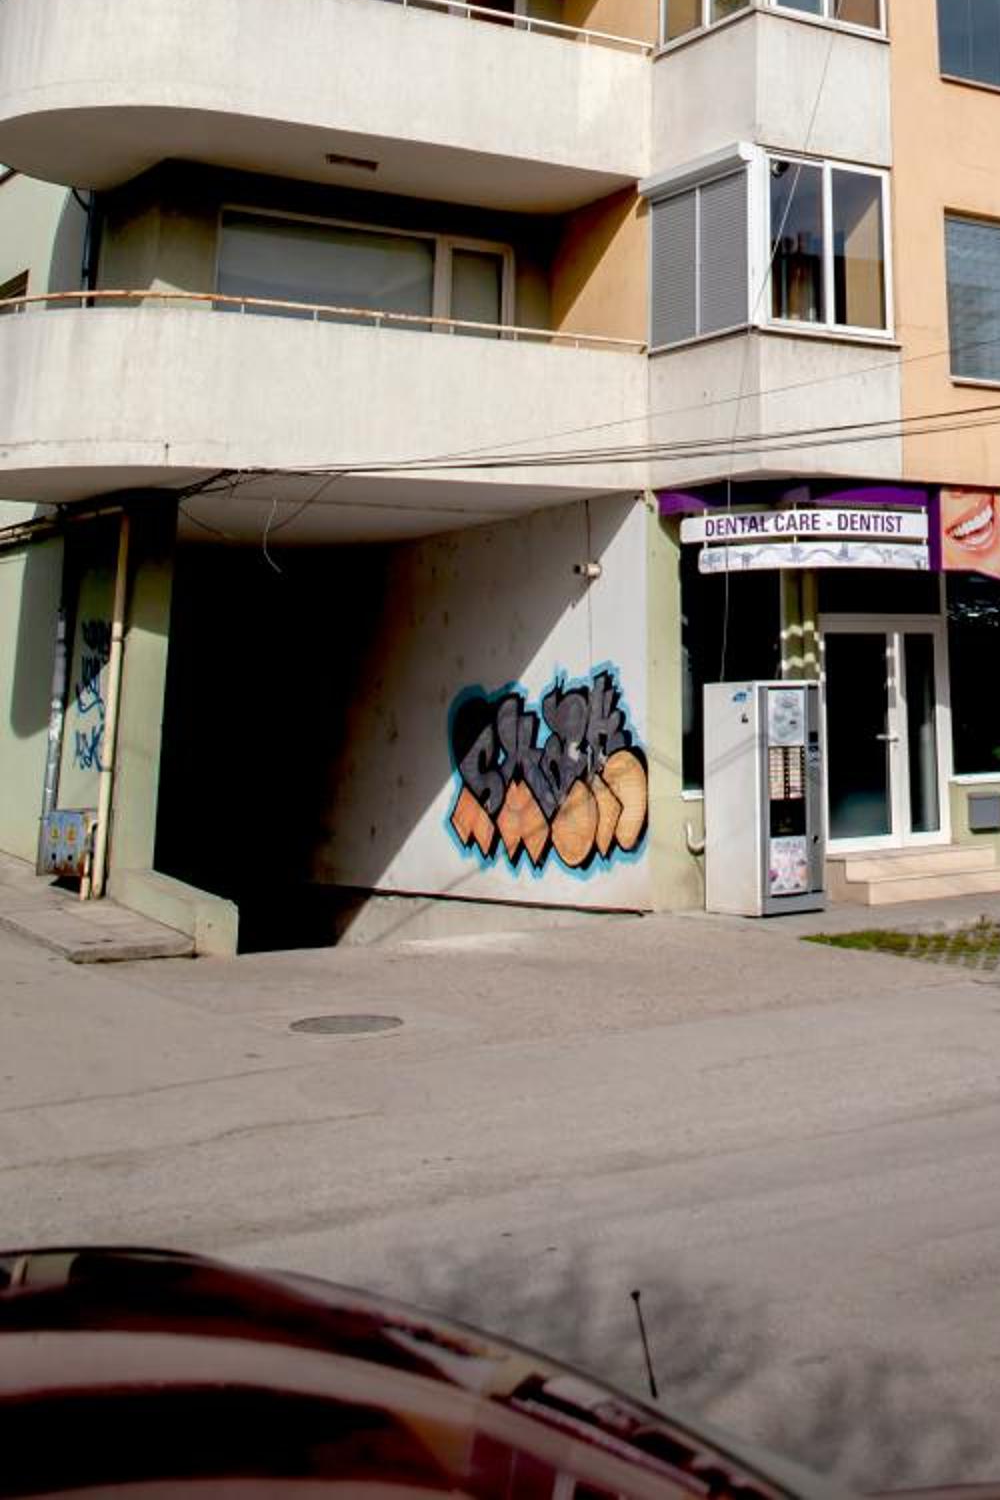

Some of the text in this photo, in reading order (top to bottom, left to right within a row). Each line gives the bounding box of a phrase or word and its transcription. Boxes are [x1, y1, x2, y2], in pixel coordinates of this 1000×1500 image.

[705, 514, 770, 536] DENTAL
[774, 513, 821, 532] CARE
[837, 513, 903, 532] DENTIST
